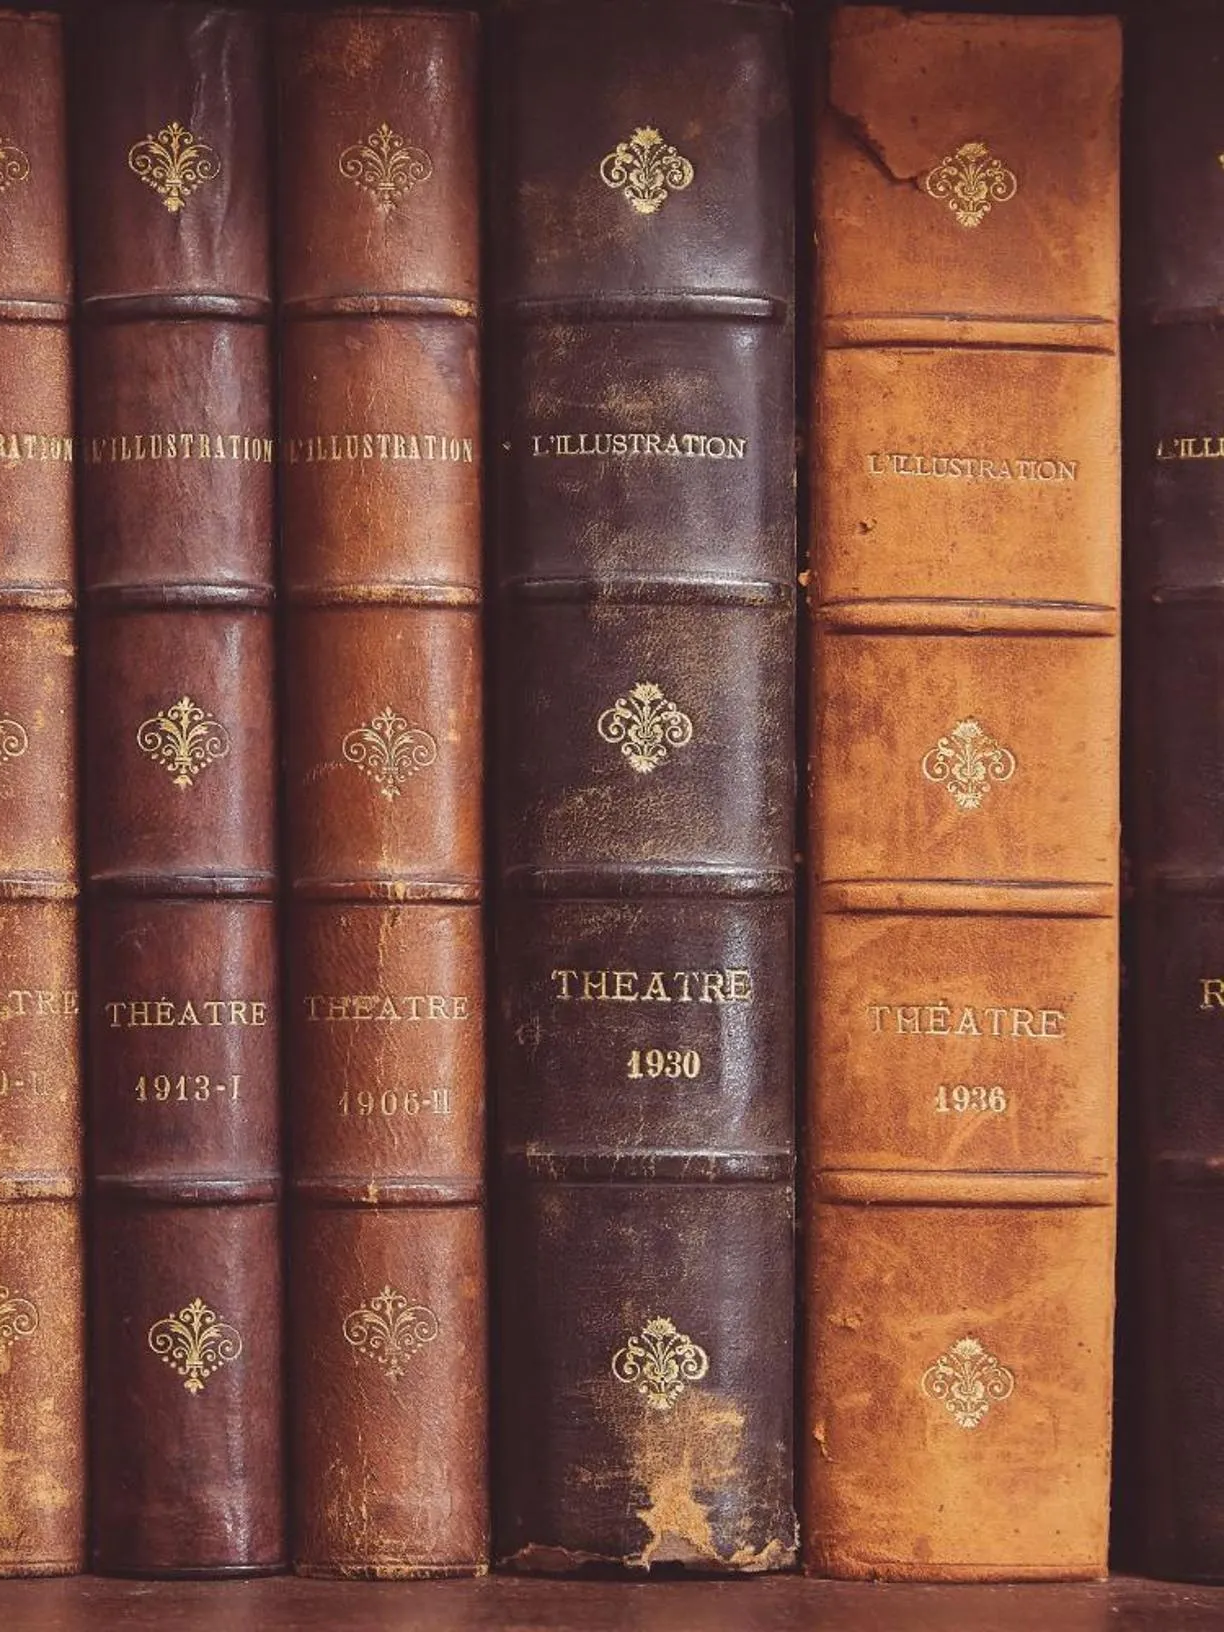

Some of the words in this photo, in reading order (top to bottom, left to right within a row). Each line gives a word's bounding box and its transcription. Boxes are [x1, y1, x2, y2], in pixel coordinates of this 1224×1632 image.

[92, 432, 273, 463] L'ILLUSTRATION
[290, 433, 473, 464] L'ILLUSTRATION
[532, 433, 746, 459] L'ILLUSTRATION
[867, 452, 1077, 481] L'ILLUSTRATION
[106, 997, 268, 1026] THÉATRE
[627, 1050, 702, 1079] 1930
[134, 1074, 242, 1101] 1913-I
[338, 1088, 453, 1116] 1906-II
[935, 1085, 1007, 1113] 1936
